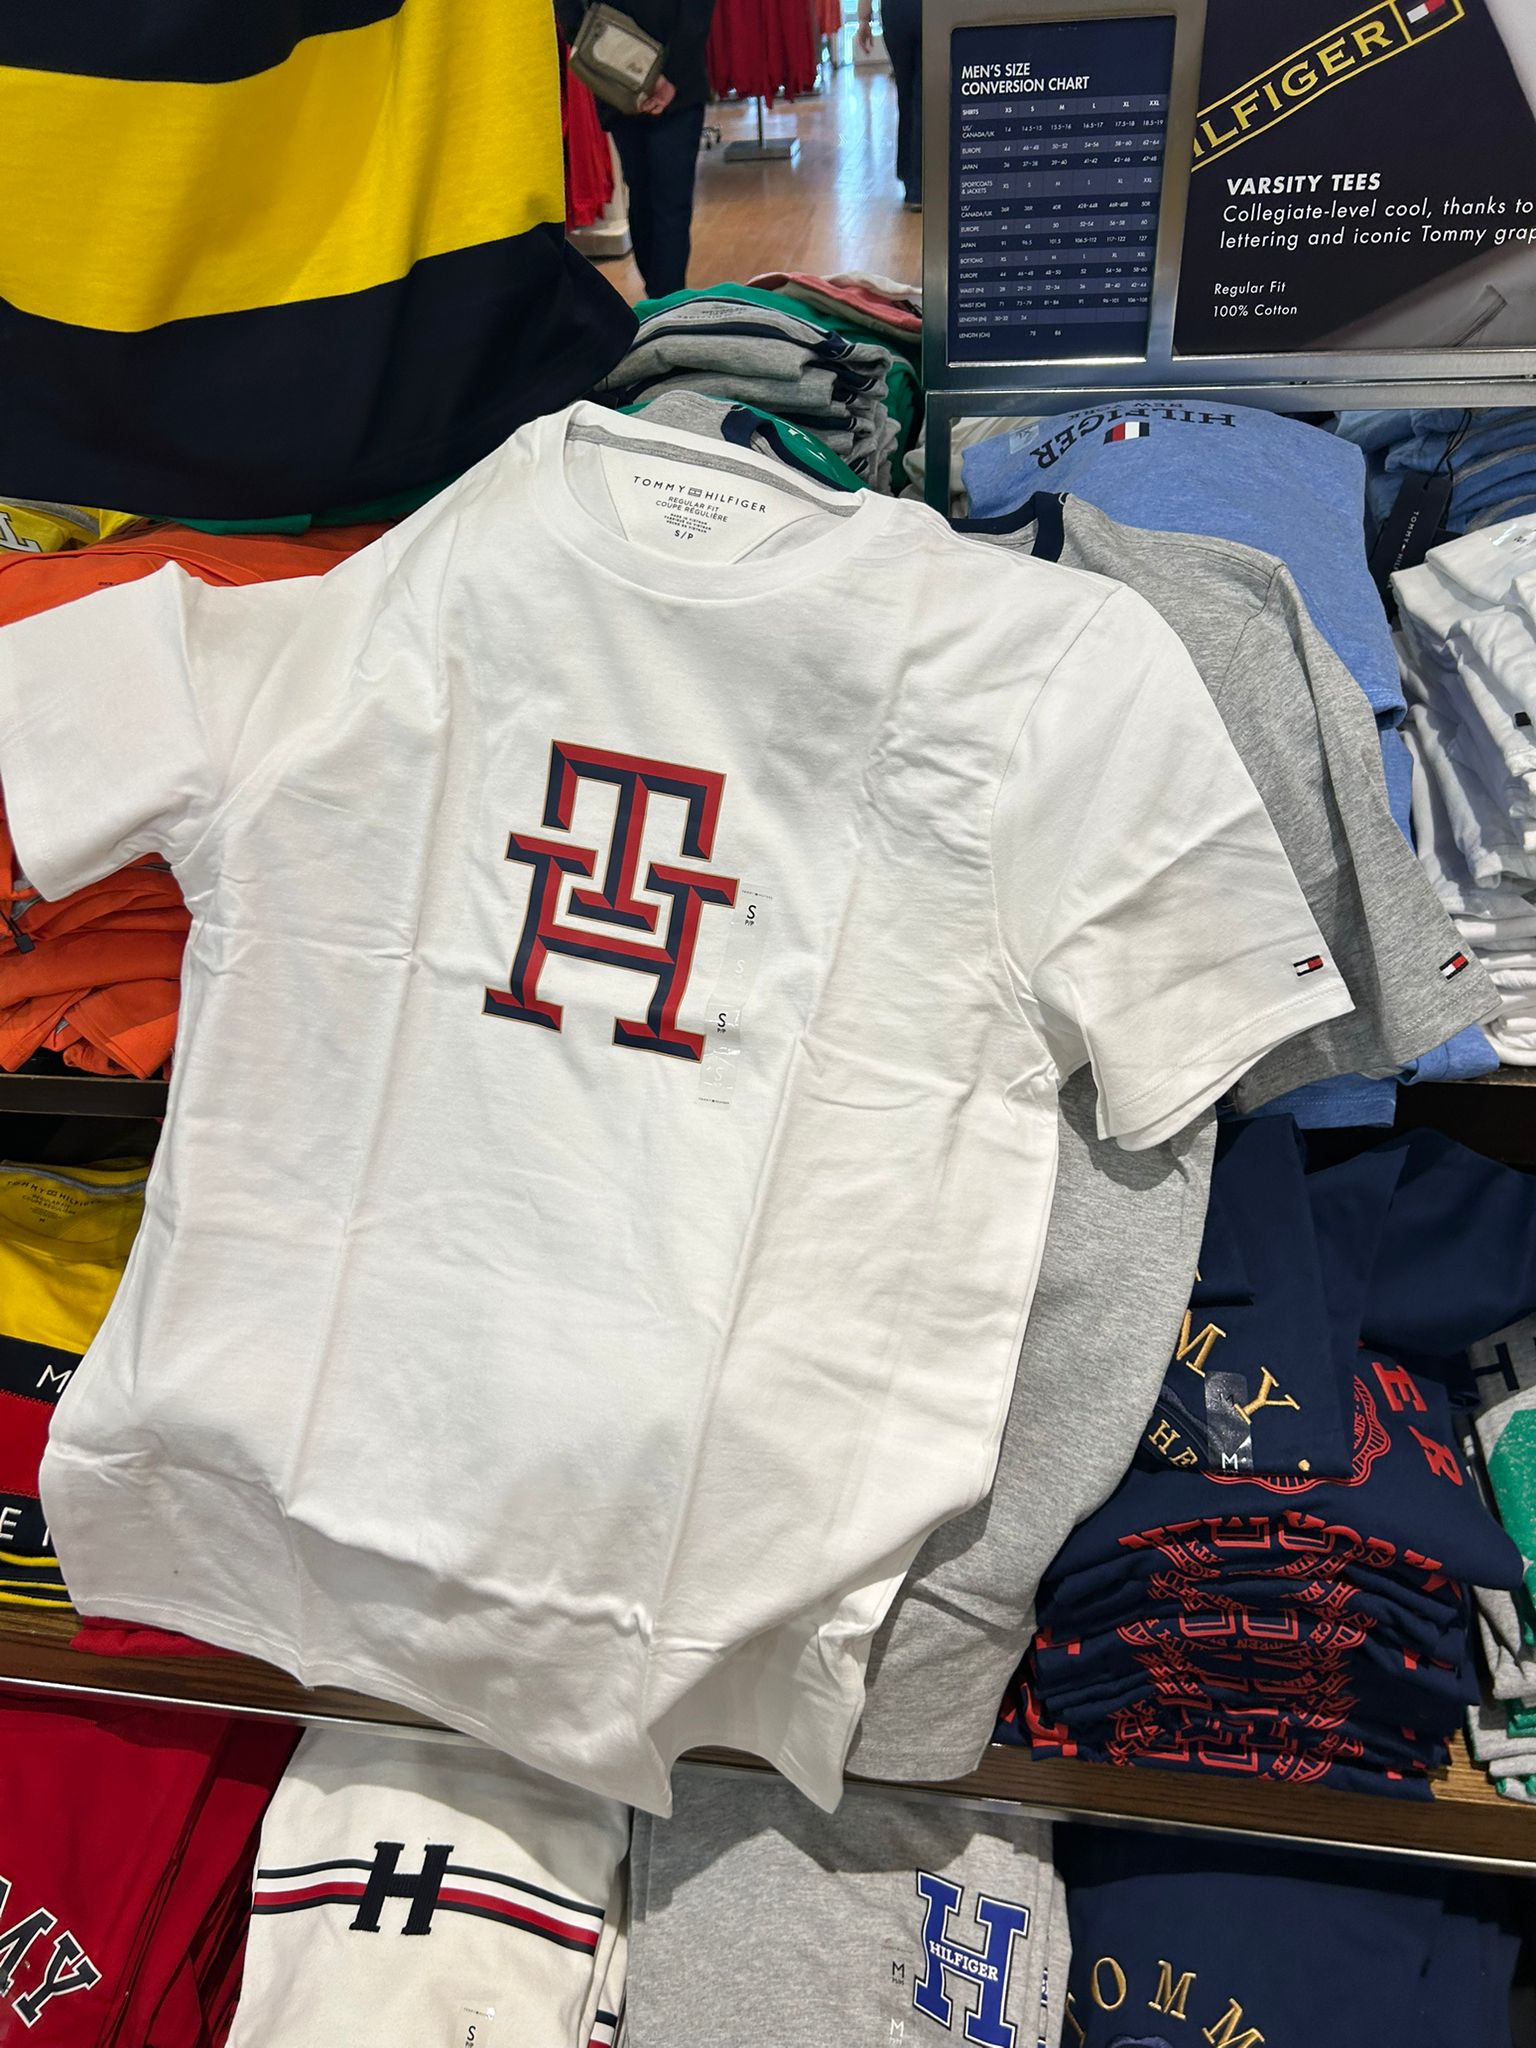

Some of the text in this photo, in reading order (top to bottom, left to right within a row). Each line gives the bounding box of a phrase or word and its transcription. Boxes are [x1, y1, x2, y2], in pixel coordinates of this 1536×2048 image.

[961, 62, 1031, 79] MEN'S SIZE
[961, 76, 1090, 96] CONVERSION CHART
[962, 108, 979, 116] SHIRTS
[1226, 172, 1382, 196] VARSITY TEES
[960, 210, 993, 218] CANADA/UK
[1223, 195, 1534, 226] Collegiate-level cool, thanks to
[1219, 224, 1536, 251] lettering and iconic Tommy grap
[960, 272, 978, 280] EUROPE
[1214, 281, 1287, 298] Regular Fit
[1212, 303, 1298, 317] 100% Cotton
[1030, 408, 1236, 469] HILFIGER
[633, 475, 767, 513] TOMMY HILFIGER
[655, 500, 728, 522] COUPE RÉGULIÈRE
[668, 496, 720, 512] REGULAR FIT
[674, 529, 694, 540] S/P
[1405, 511, 1419, 543] TOMMY
[746, 904, 757, 920] S
[717, 1013, 727, 1028] S
[1221, 1452, 1239, 1470] M
[349, 1840, 455, 1936] H
[913, 1867, 1031, 2048] H
[929, 1940, 999, 1982] HILFIGER
[892, 1961, 905, 1978] M
[467, 2025, 476, 2041] S
[890, 2018, 904, 2038] M
